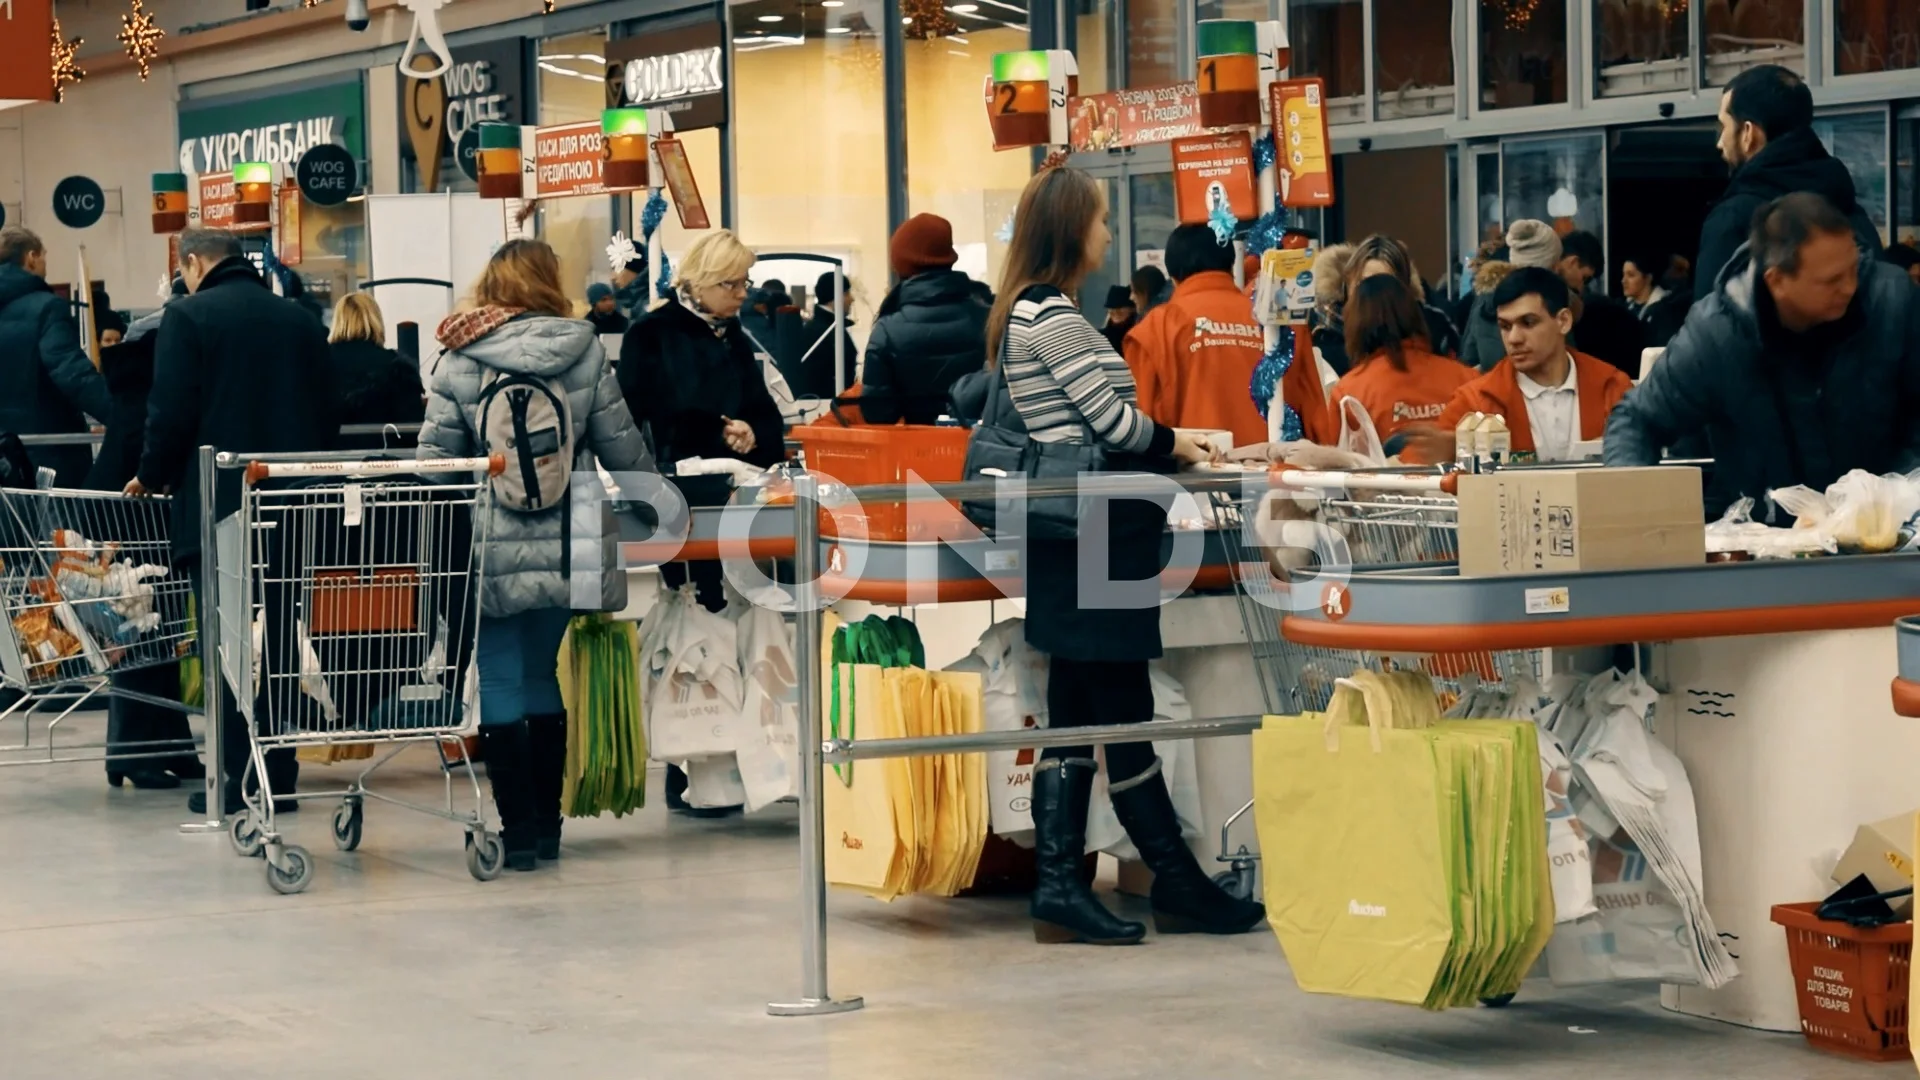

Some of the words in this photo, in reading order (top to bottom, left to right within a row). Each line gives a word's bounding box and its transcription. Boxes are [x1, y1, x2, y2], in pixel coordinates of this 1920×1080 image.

[444, 60, 486, 97] WOG
[1051, 86, 1065, 108] 72
[447, 95, 501, 144] CAFE
[200, 115, 334, 175] УКРСИББАНК
[538, 140, 558, 158] КАСИ
[559, 136, 578, 158] ДЛЯ
[579, 132, 603, 152] РОЗ
[310, 161, 344, 174] WOG
[524, 156, 535, 173] 74
[538, 160, 593, 185] КРЕДИТНОЮ
[308, 177, 346, 190] CAFE
[63, 194, 95, 210] WC
[1007, 771, 1032, 787] УДА
[1813, 965, 1845, 982] КОШИК
[1807, 979, 1826, 993] ДЛЯ
[1826, 983, 1853, 999] ЗБОРУ
[1814, 995, 1851, 1013] ТОВАРІВ
